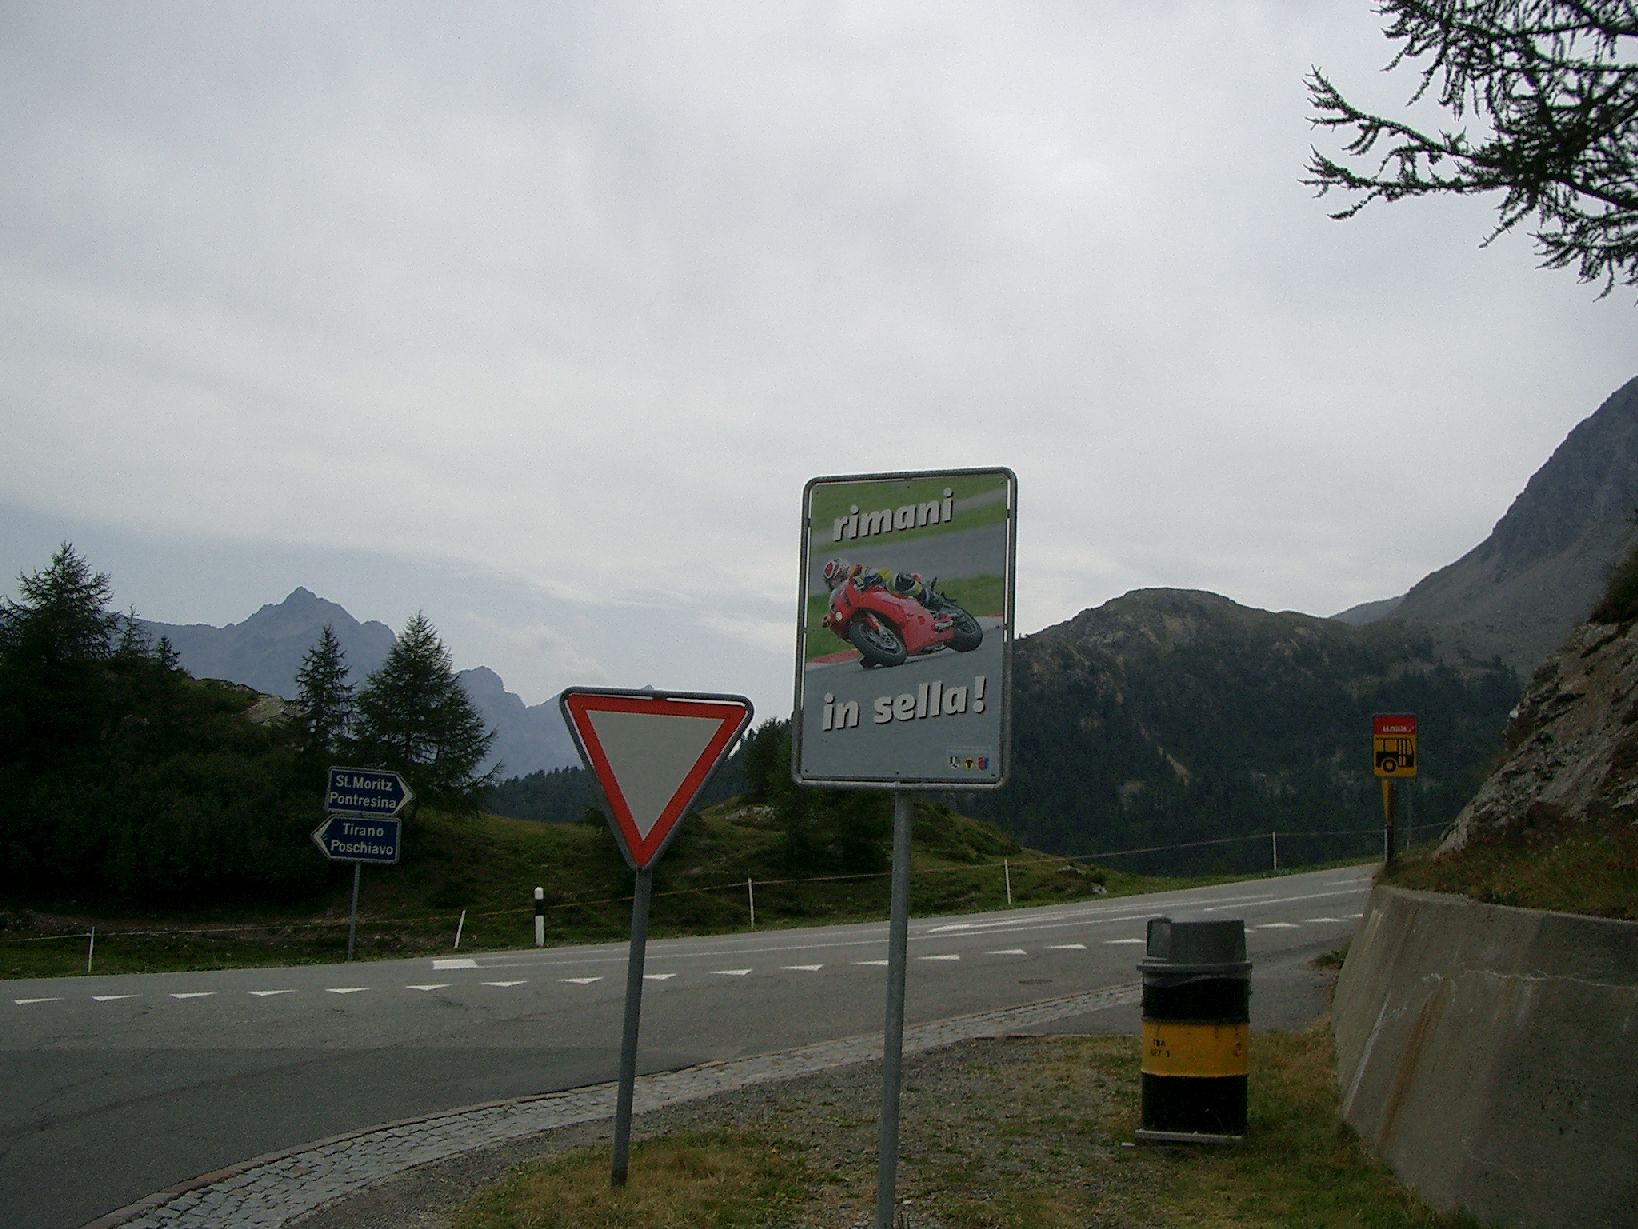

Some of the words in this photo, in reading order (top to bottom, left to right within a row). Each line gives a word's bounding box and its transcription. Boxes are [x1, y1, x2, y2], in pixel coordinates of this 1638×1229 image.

[833, 487, 954, 542] rimani
[822, 693, 860, 731] in
[874, 676, 987, 724] sella!
[329, 791, 397, 809] Pontresina
[343, 823, 384, 837] Tirano
[330, 840, 394, 855] Poschiavo
